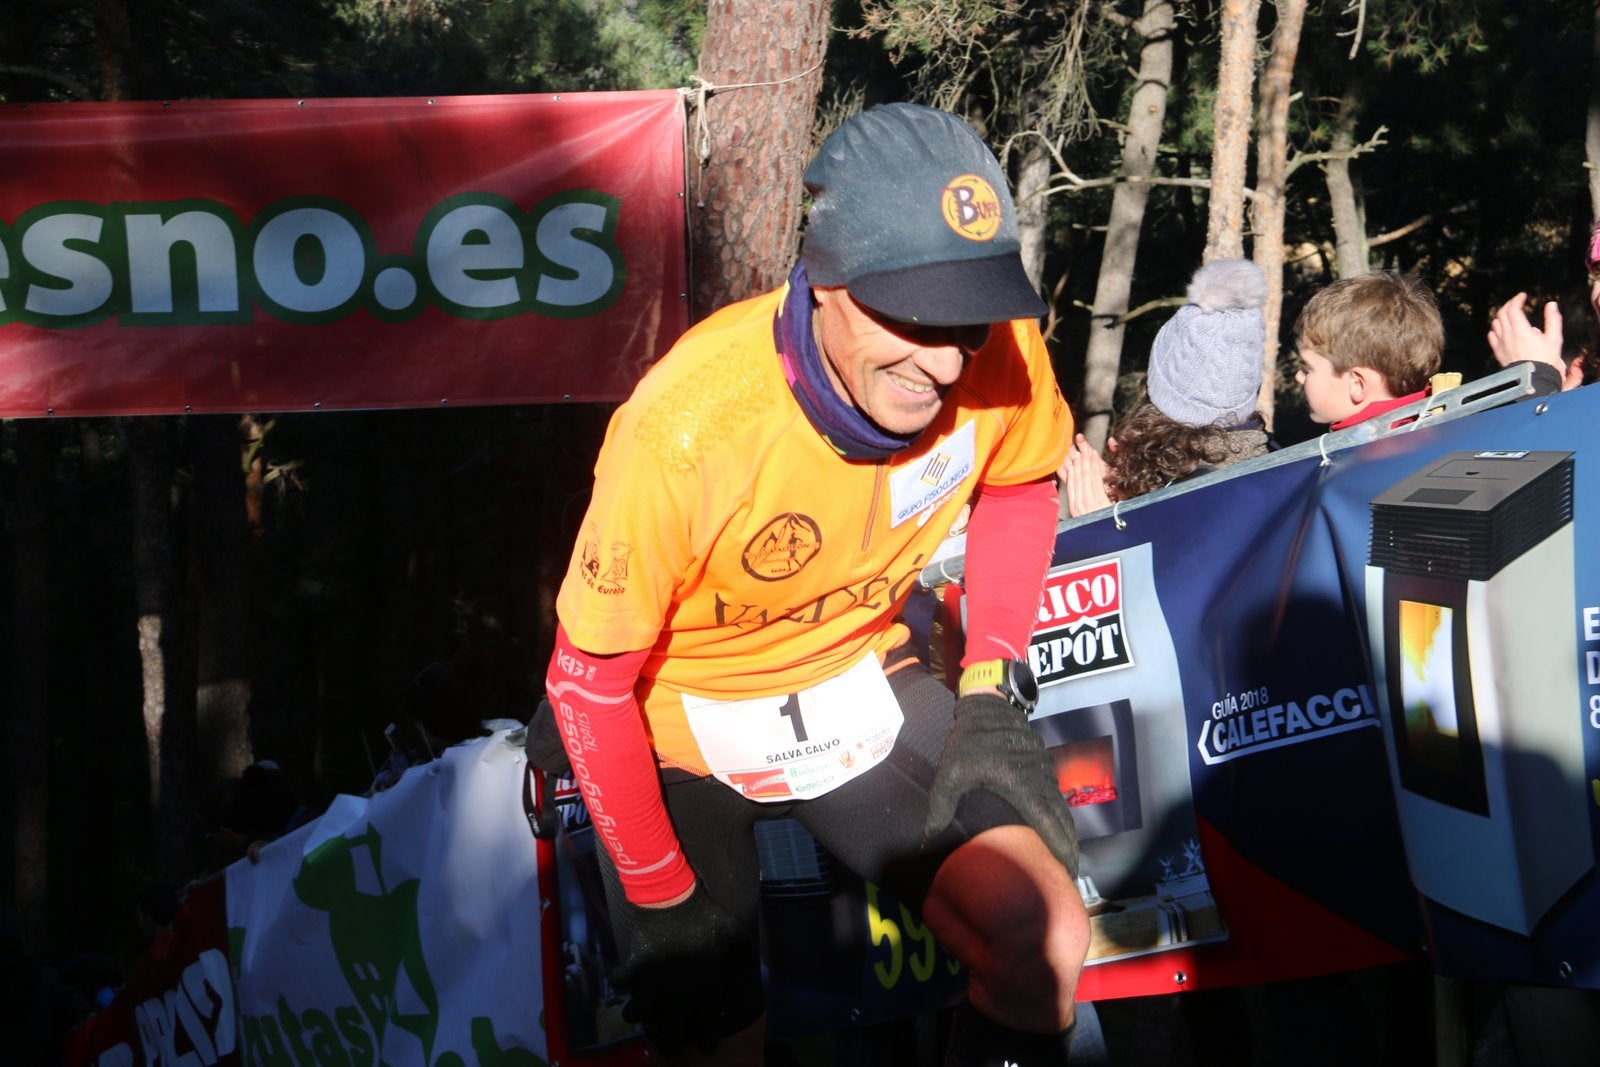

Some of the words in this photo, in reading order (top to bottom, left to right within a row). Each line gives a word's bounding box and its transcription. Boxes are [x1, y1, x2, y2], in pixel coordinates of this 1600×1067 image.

[0, 201, 615, 317] sno.es
[779, 691, 809, 743] 1
[1212, 693, 1239, 720] GUÍA
[1240, 686, 1269, 711] 2018
[766, 747, 804, 764] SALVA
[805, 738, 841, 756] CALVO
[559, 702, 637, 866] penyagolosa
